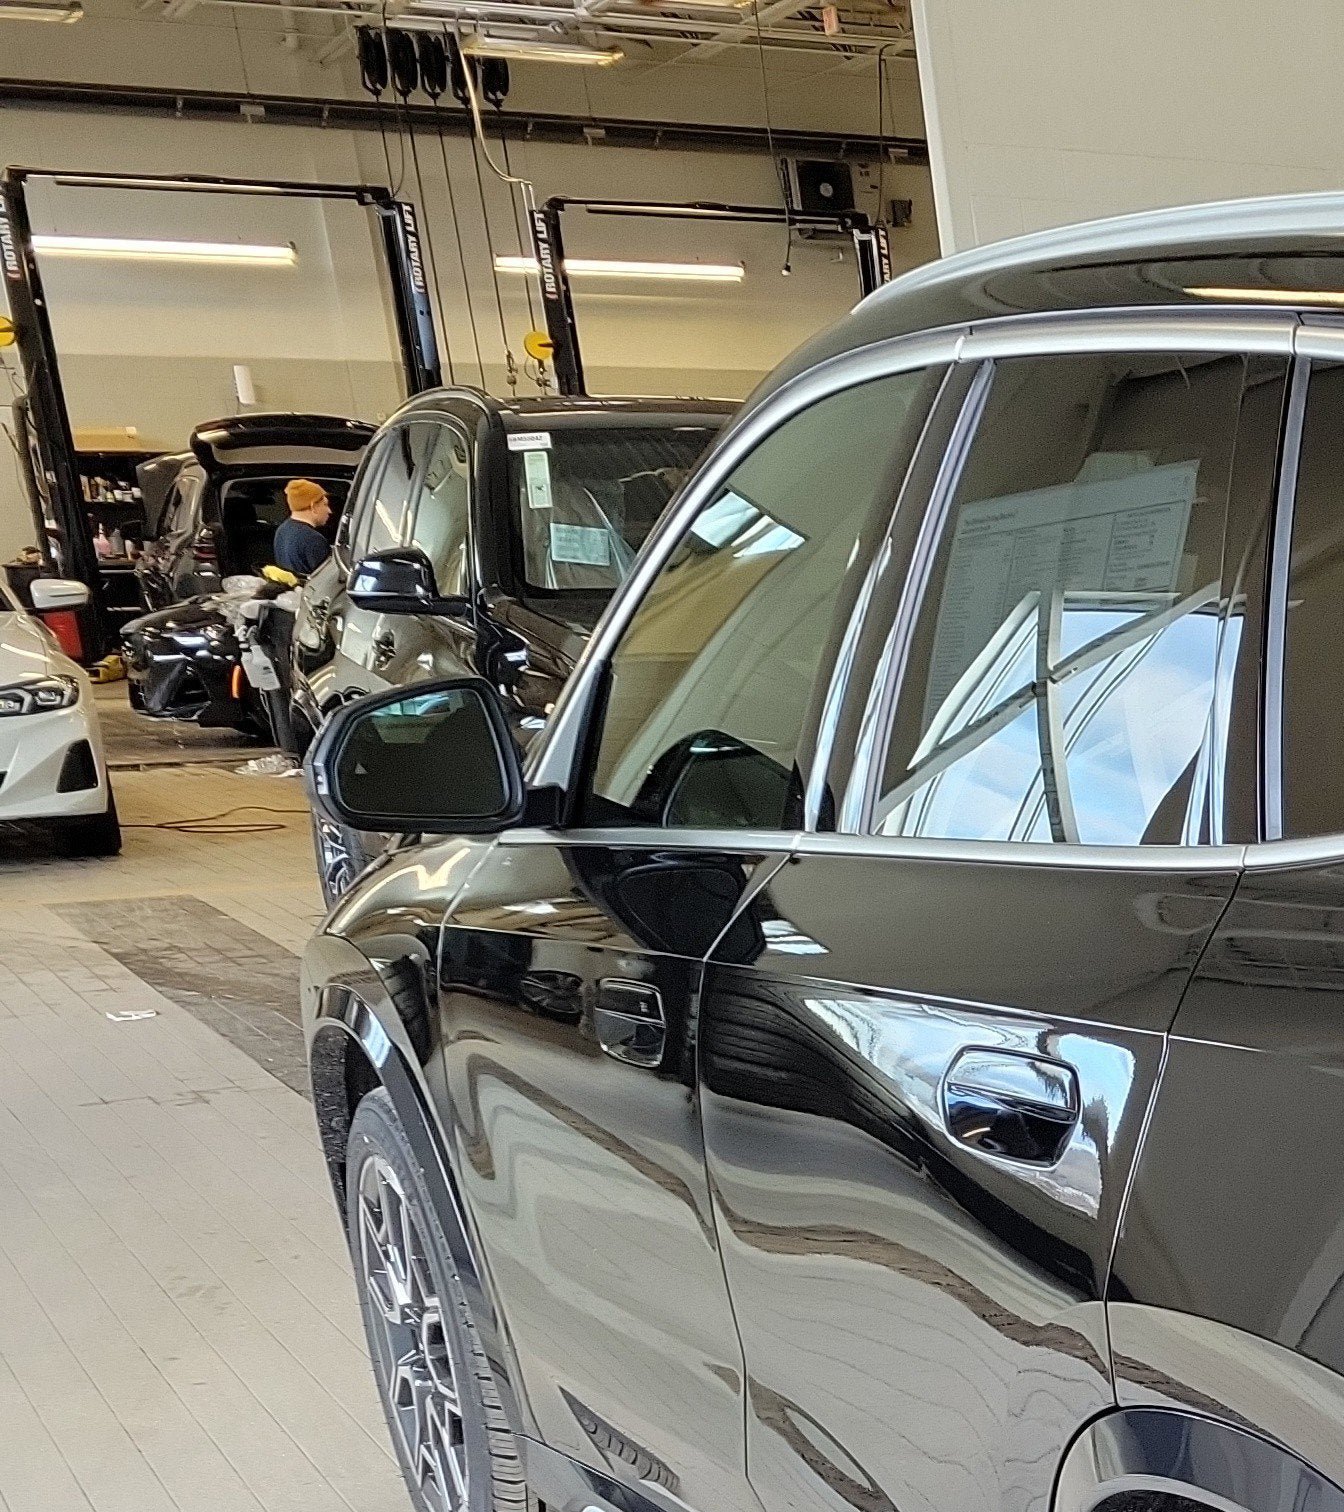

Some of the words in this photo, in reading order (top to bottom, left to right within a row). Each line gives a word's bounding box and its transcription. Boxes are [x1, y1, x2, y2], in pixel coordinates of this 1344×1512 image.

[402, 203, 417, 231] LIFT
[533, 212, 548, 239] LIFT
[407, 233, 425, 289] ROTARY
[538, 241, 558, 291] ROTARY
